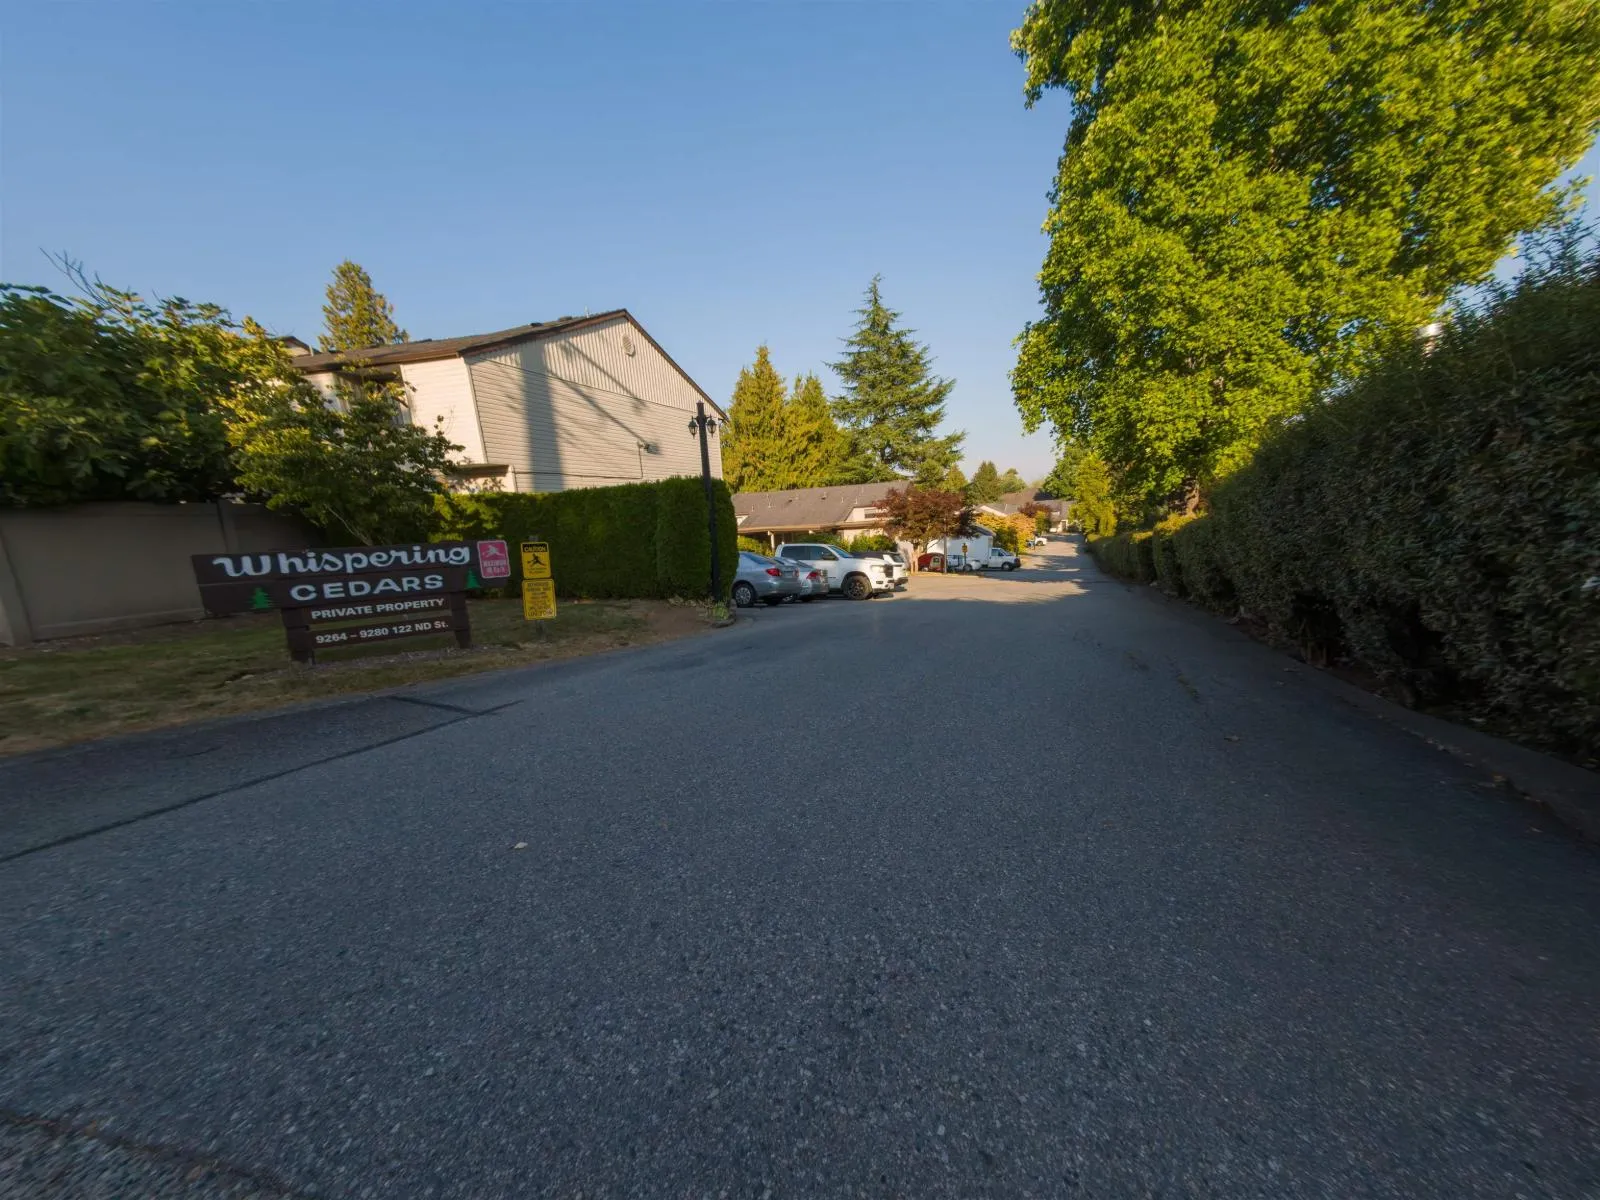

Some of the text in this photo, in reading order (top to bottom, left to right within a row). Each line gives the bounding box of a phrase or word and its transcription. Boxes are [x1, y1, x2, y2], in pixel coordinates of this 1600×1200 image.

[212, 544, 471, 578] Whispering
[290, 575, 444, 601] CEDARS
[311, 599, 445, 620] PRIVATE PROPERTY
[315, 632, 348, 645] 9264
[359, 627, 389, 639] 9280
[392, 624, 412, 635] 122
[415, 622, 432, 632] ND
[433, 620, 449, 630] St.
